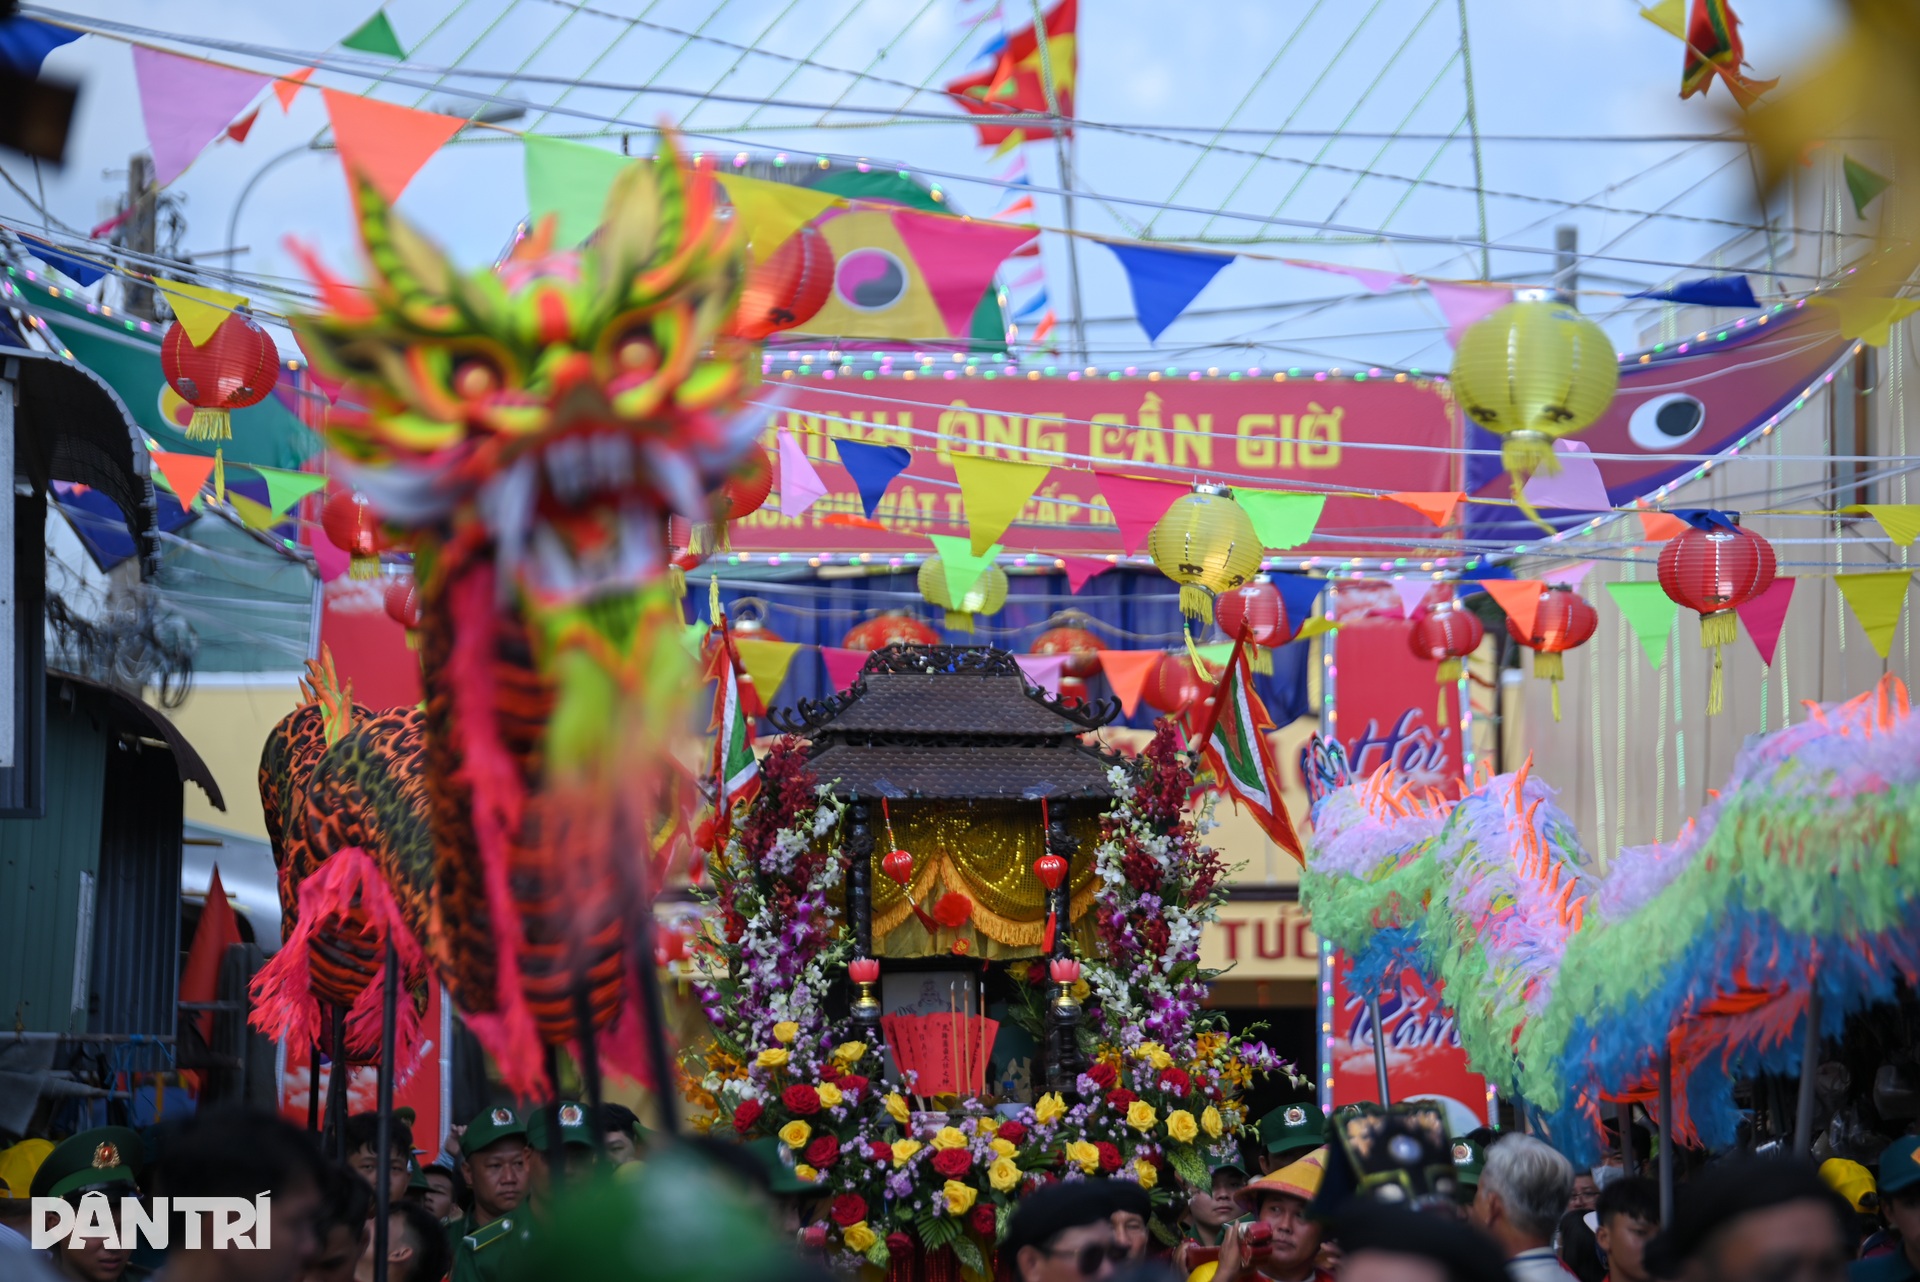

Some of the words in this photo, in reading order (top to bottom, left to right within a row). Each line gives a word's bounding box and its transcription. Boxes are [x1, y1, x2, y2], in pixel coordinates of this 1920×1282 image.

[936, 399, 1067, 466] ÔNG
[1090, 391, 1214, 467] CẦN
[1236, 401, 1345, 469] GIỜ
